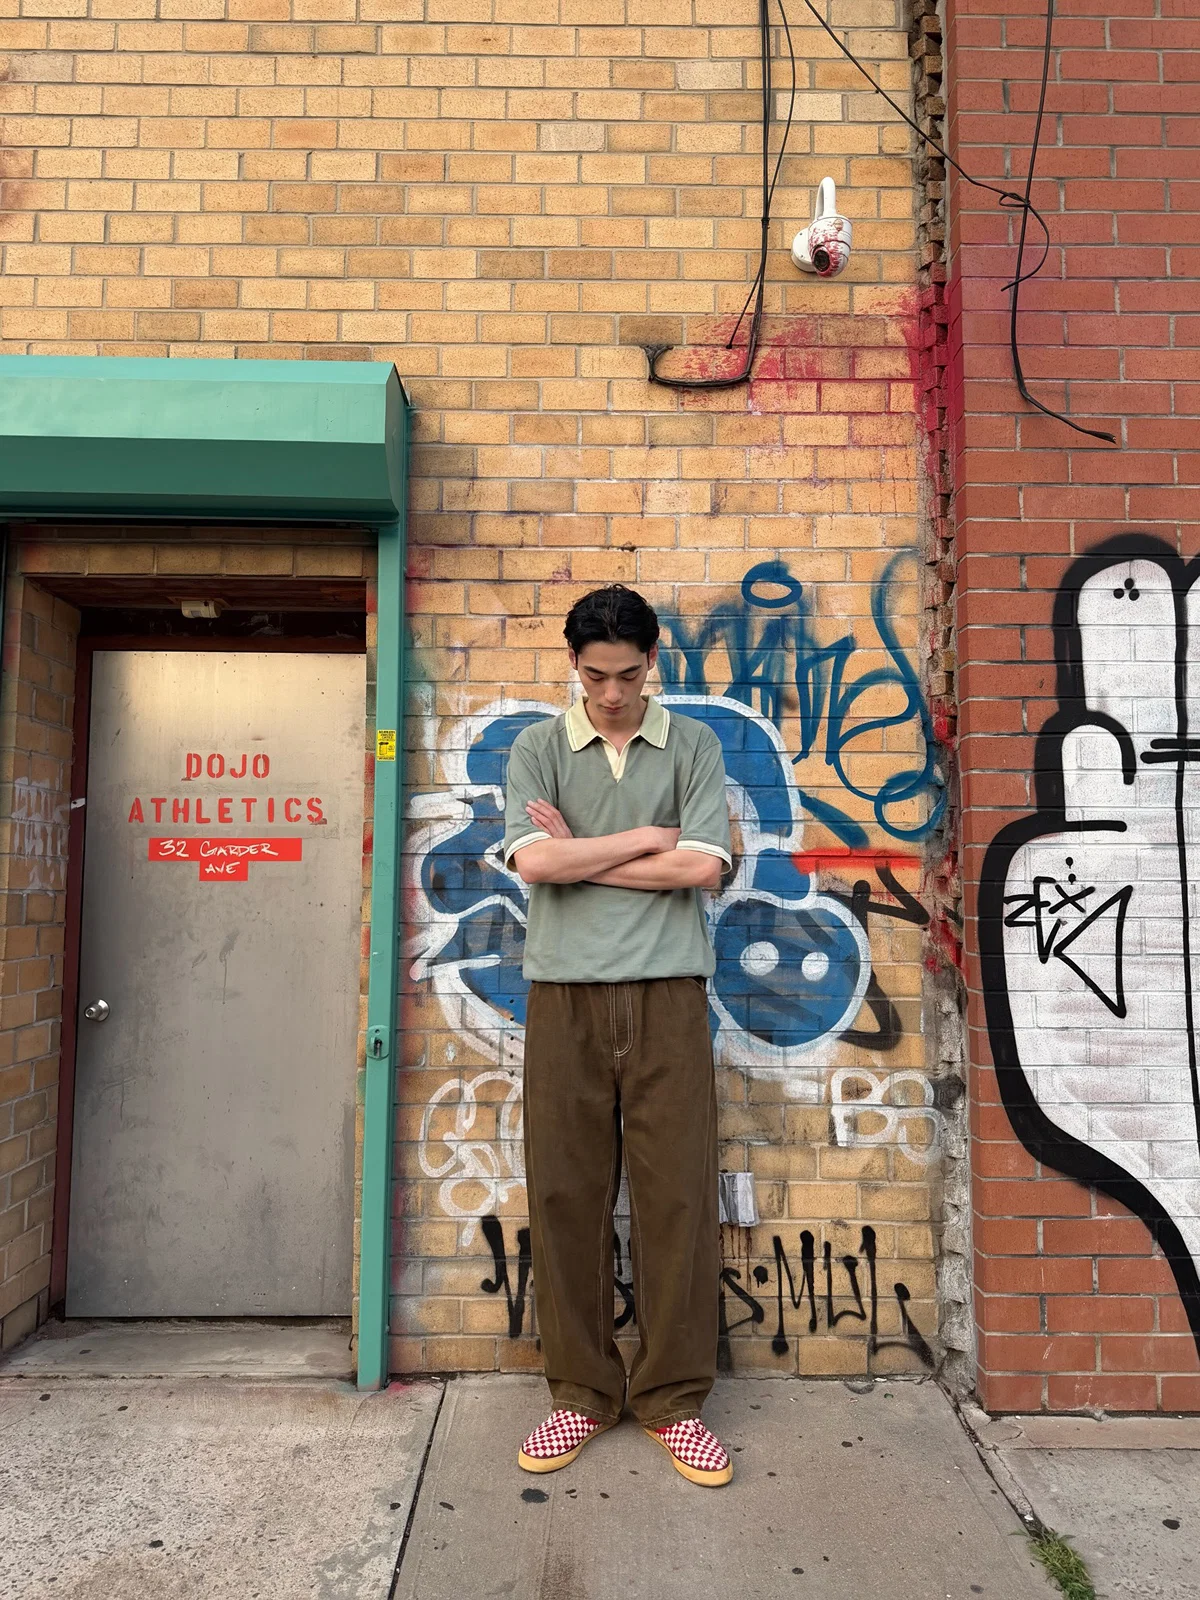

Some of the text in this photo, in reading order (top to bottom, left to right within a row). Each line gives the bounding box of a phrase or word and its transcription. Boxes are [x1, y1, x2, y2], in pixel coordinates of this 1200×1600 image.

[186, 753, 270, 779] DOJO
[128, 797, 325, 824] ATHLETICS
[158, 840, 190, 858] 32
[204, 861, 241, 875] AVE
